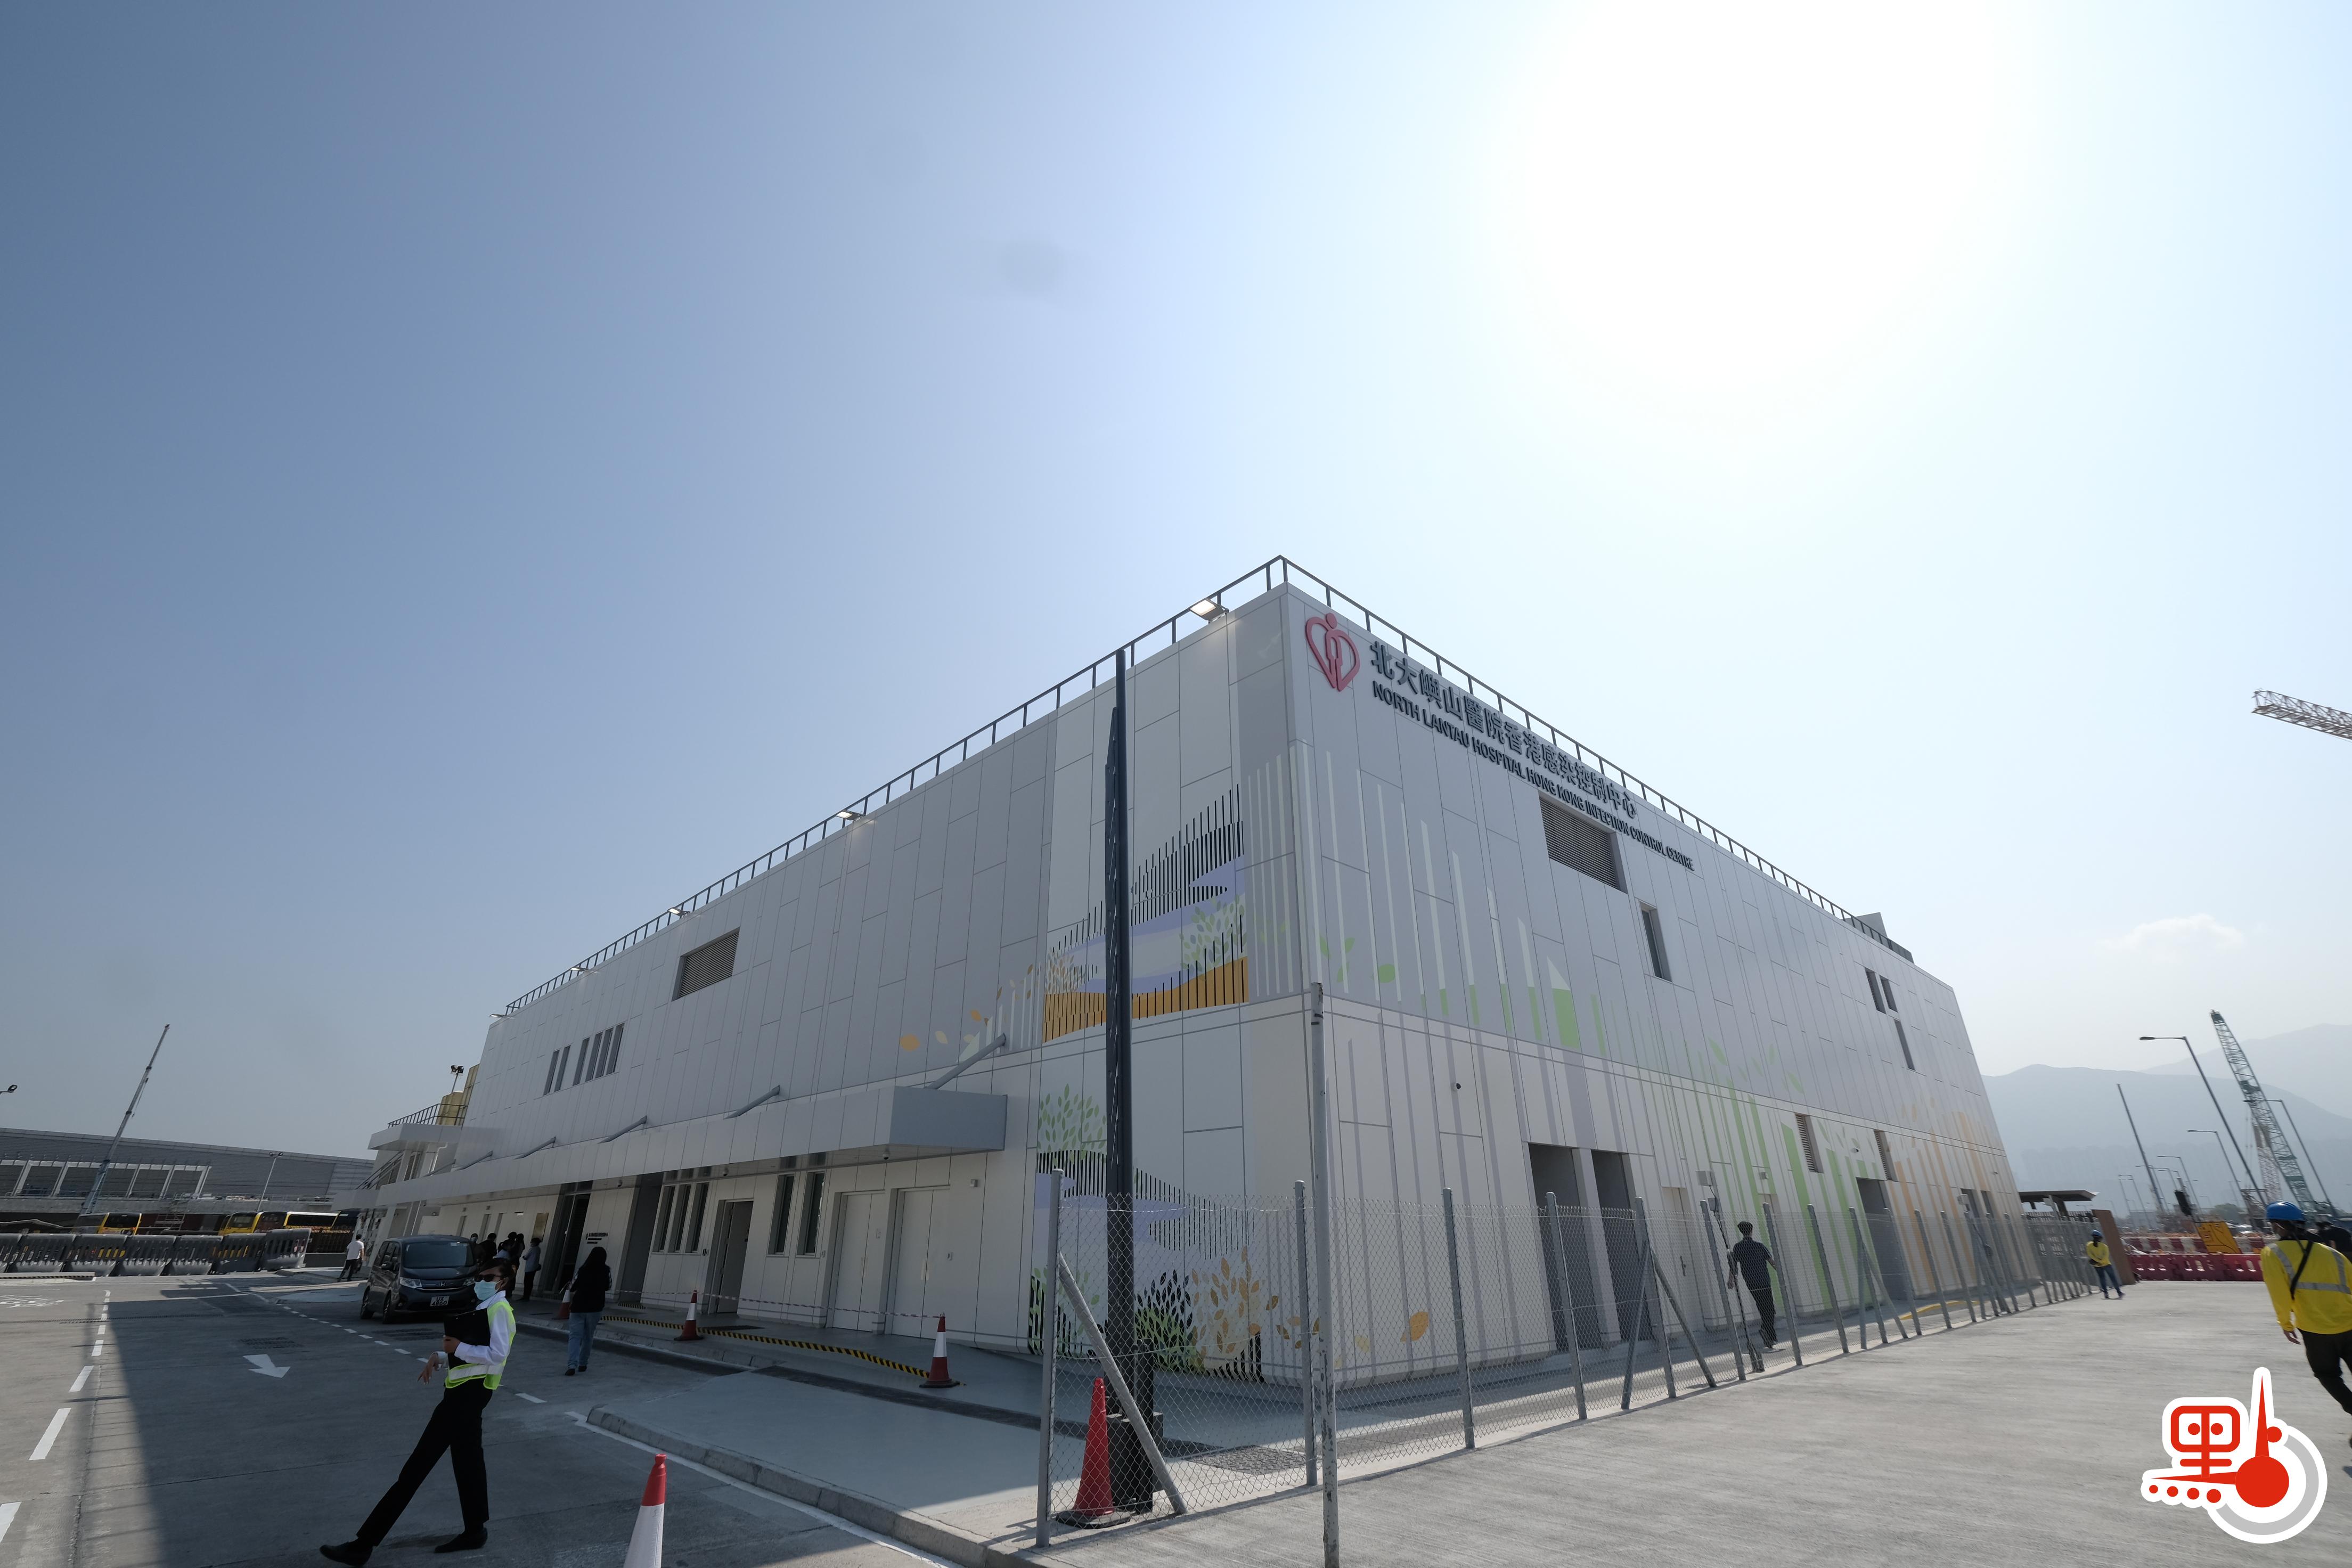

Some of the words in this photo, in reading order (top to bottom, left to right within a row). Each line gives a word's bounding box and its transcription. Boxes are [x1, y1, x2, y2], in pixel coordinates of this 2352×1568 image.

[1370, 641, 1637, 819] 北大嶼山醫院香港感染控制中心
[1373, 680, 1420, 721] NORTH
[1422, 708, 1470, 748] LANTAU
[1471, 737, 1526, 779] HOSPITAL
[1525, 766, 1556, 796] HONG
[1556, 783, 1585, 812] KONG
[1585, 799, 1630, 836] INFECTION
[1629, 826, 1667, 856] CONTROL
[1665, 846, 1695, 871] CENTRE
